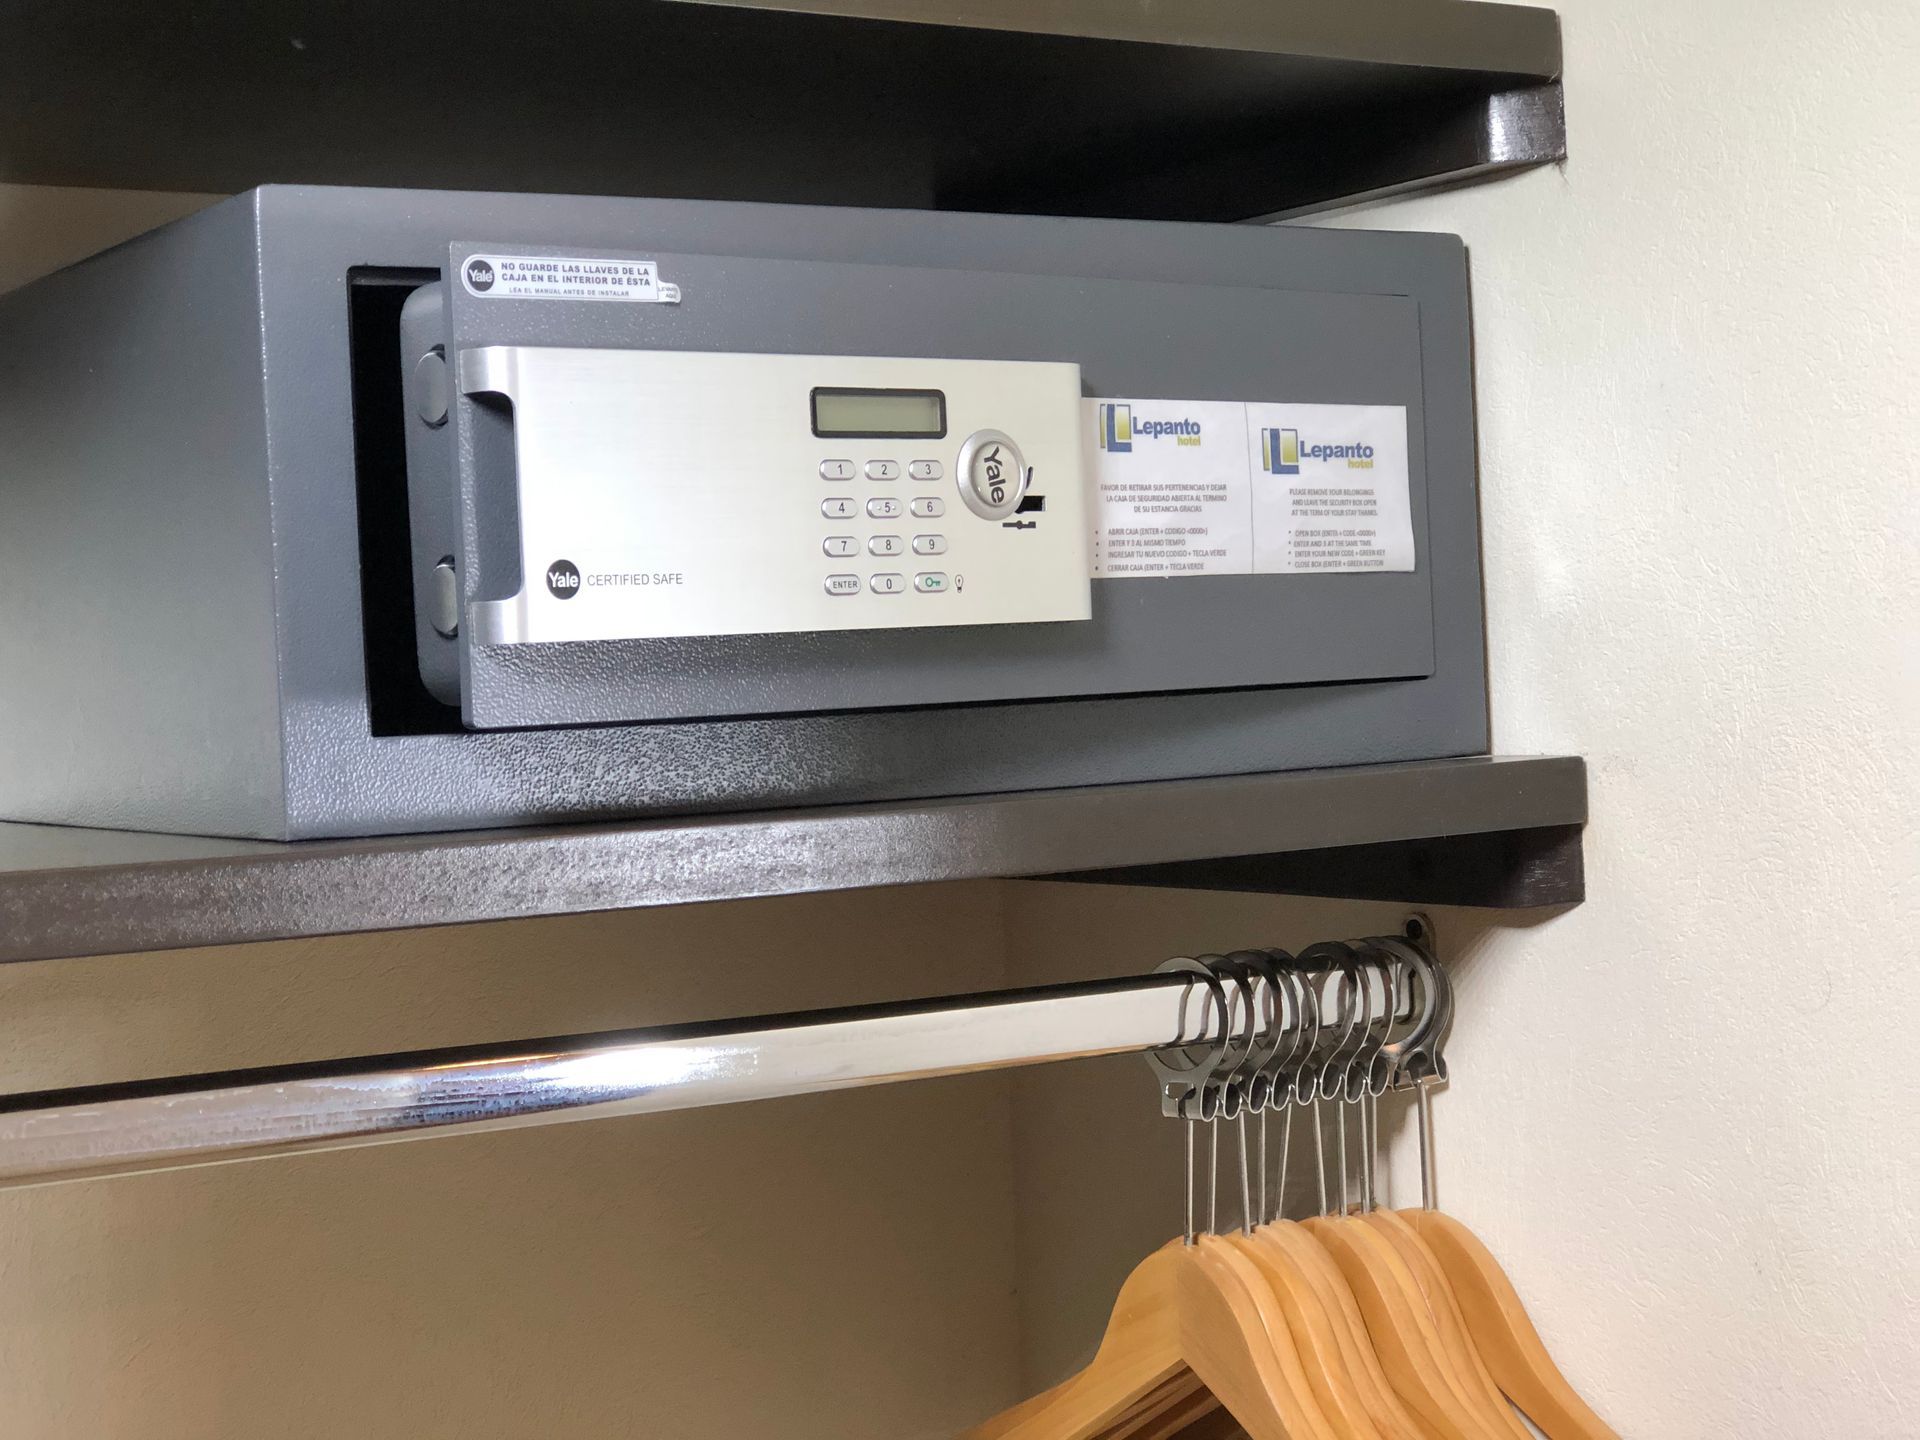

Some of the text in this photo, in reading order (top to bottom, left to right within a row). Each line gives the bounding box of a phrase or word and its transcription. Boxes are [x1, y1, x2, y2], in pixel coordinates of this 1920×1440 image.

[501, 262, 649, 276] NO GUARDE LAS LLAVES DE LA
[468, 269, 493, 283] Yale
[501, 273, 650, 286] CAJA EN EL INTERIOR DE ÉSTA
[1132, 416, 1201, 439] Lepanto
[1177, 435, 1201, 446] hotel
[1300, 440, 1374, 462] Lepanto
[1347, 458, 1374, 469] hotel
[838, 464, 843, 475] 1
[881, 464, 888, 475] 2
[925, 464, 931, 475] 3
[983, 446, 1006, 504] Yale
[838, 502, 845, 513] 4
[884, 502, 891, 513] 5
[927, 501, 933, 512] 6
[841, 541, 847, 552] 7
[885, 540, 892, 551] 8
[929, 539, 935, 550] 9
[1108, 564, 1128, 572] CERRAR
[548, 571, 579, 588] Yale
[587, 573, 683, 586] CERTIFIED SAFE
[833, 580, 858, 589] ENTER
[886, 578, 892, 590] 0
